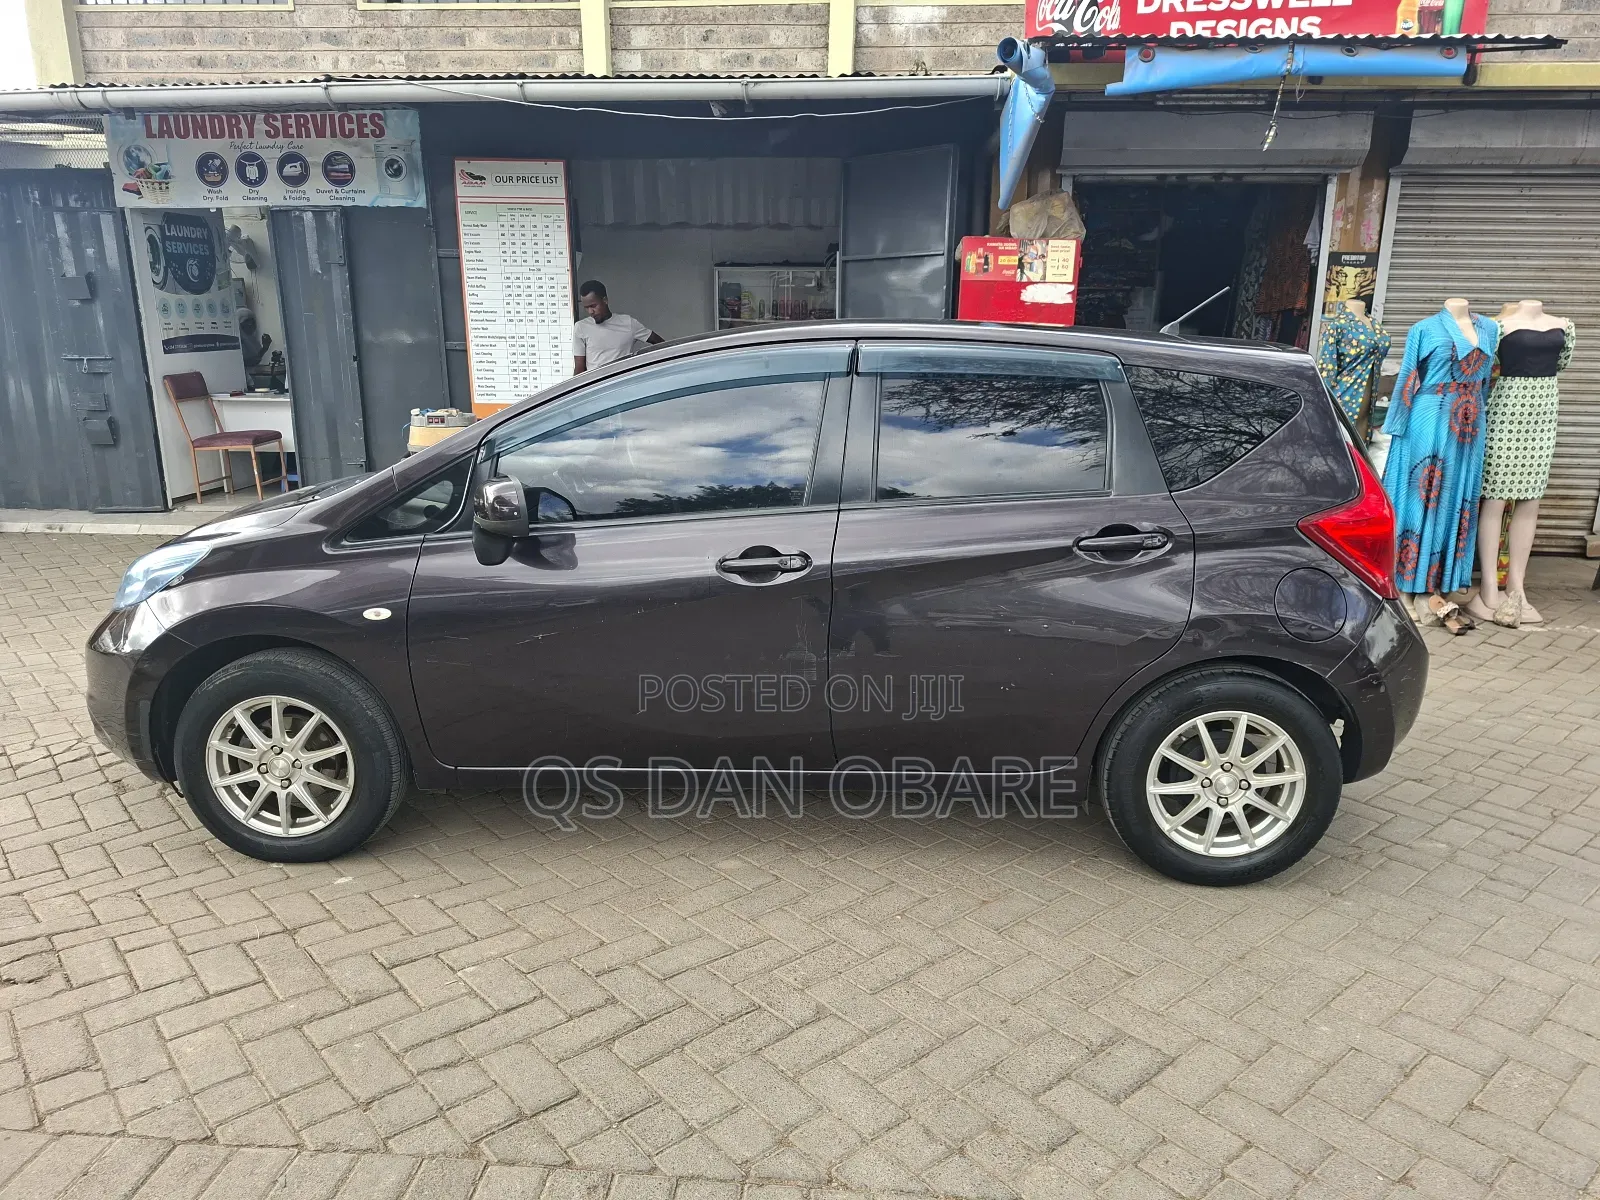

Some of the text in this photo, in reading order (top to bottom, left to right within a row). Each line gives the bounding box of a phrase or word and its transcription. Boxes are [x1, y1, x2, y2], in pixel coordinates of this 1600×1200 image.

[1170, 16, 1322, 39] DESIGNS
[144, 112, 386, 140] LAUNDRY SERVICES
[229, 141, 304, 153] Perfect Laundry Care
[495, 175, 559, 184] OUR PRICE LIST
[248, 188, 260, 196] Dry
[285, 188, 307, 196] Ironing
[242, 195, 268, 203] Cleaning
[289, 195, 311, 203] Folding
[329, 195, 356, 203] Cleaning
[164, 224, 208, 240] LAUNDRY
[165, 241, 210, 256] SERVICES
